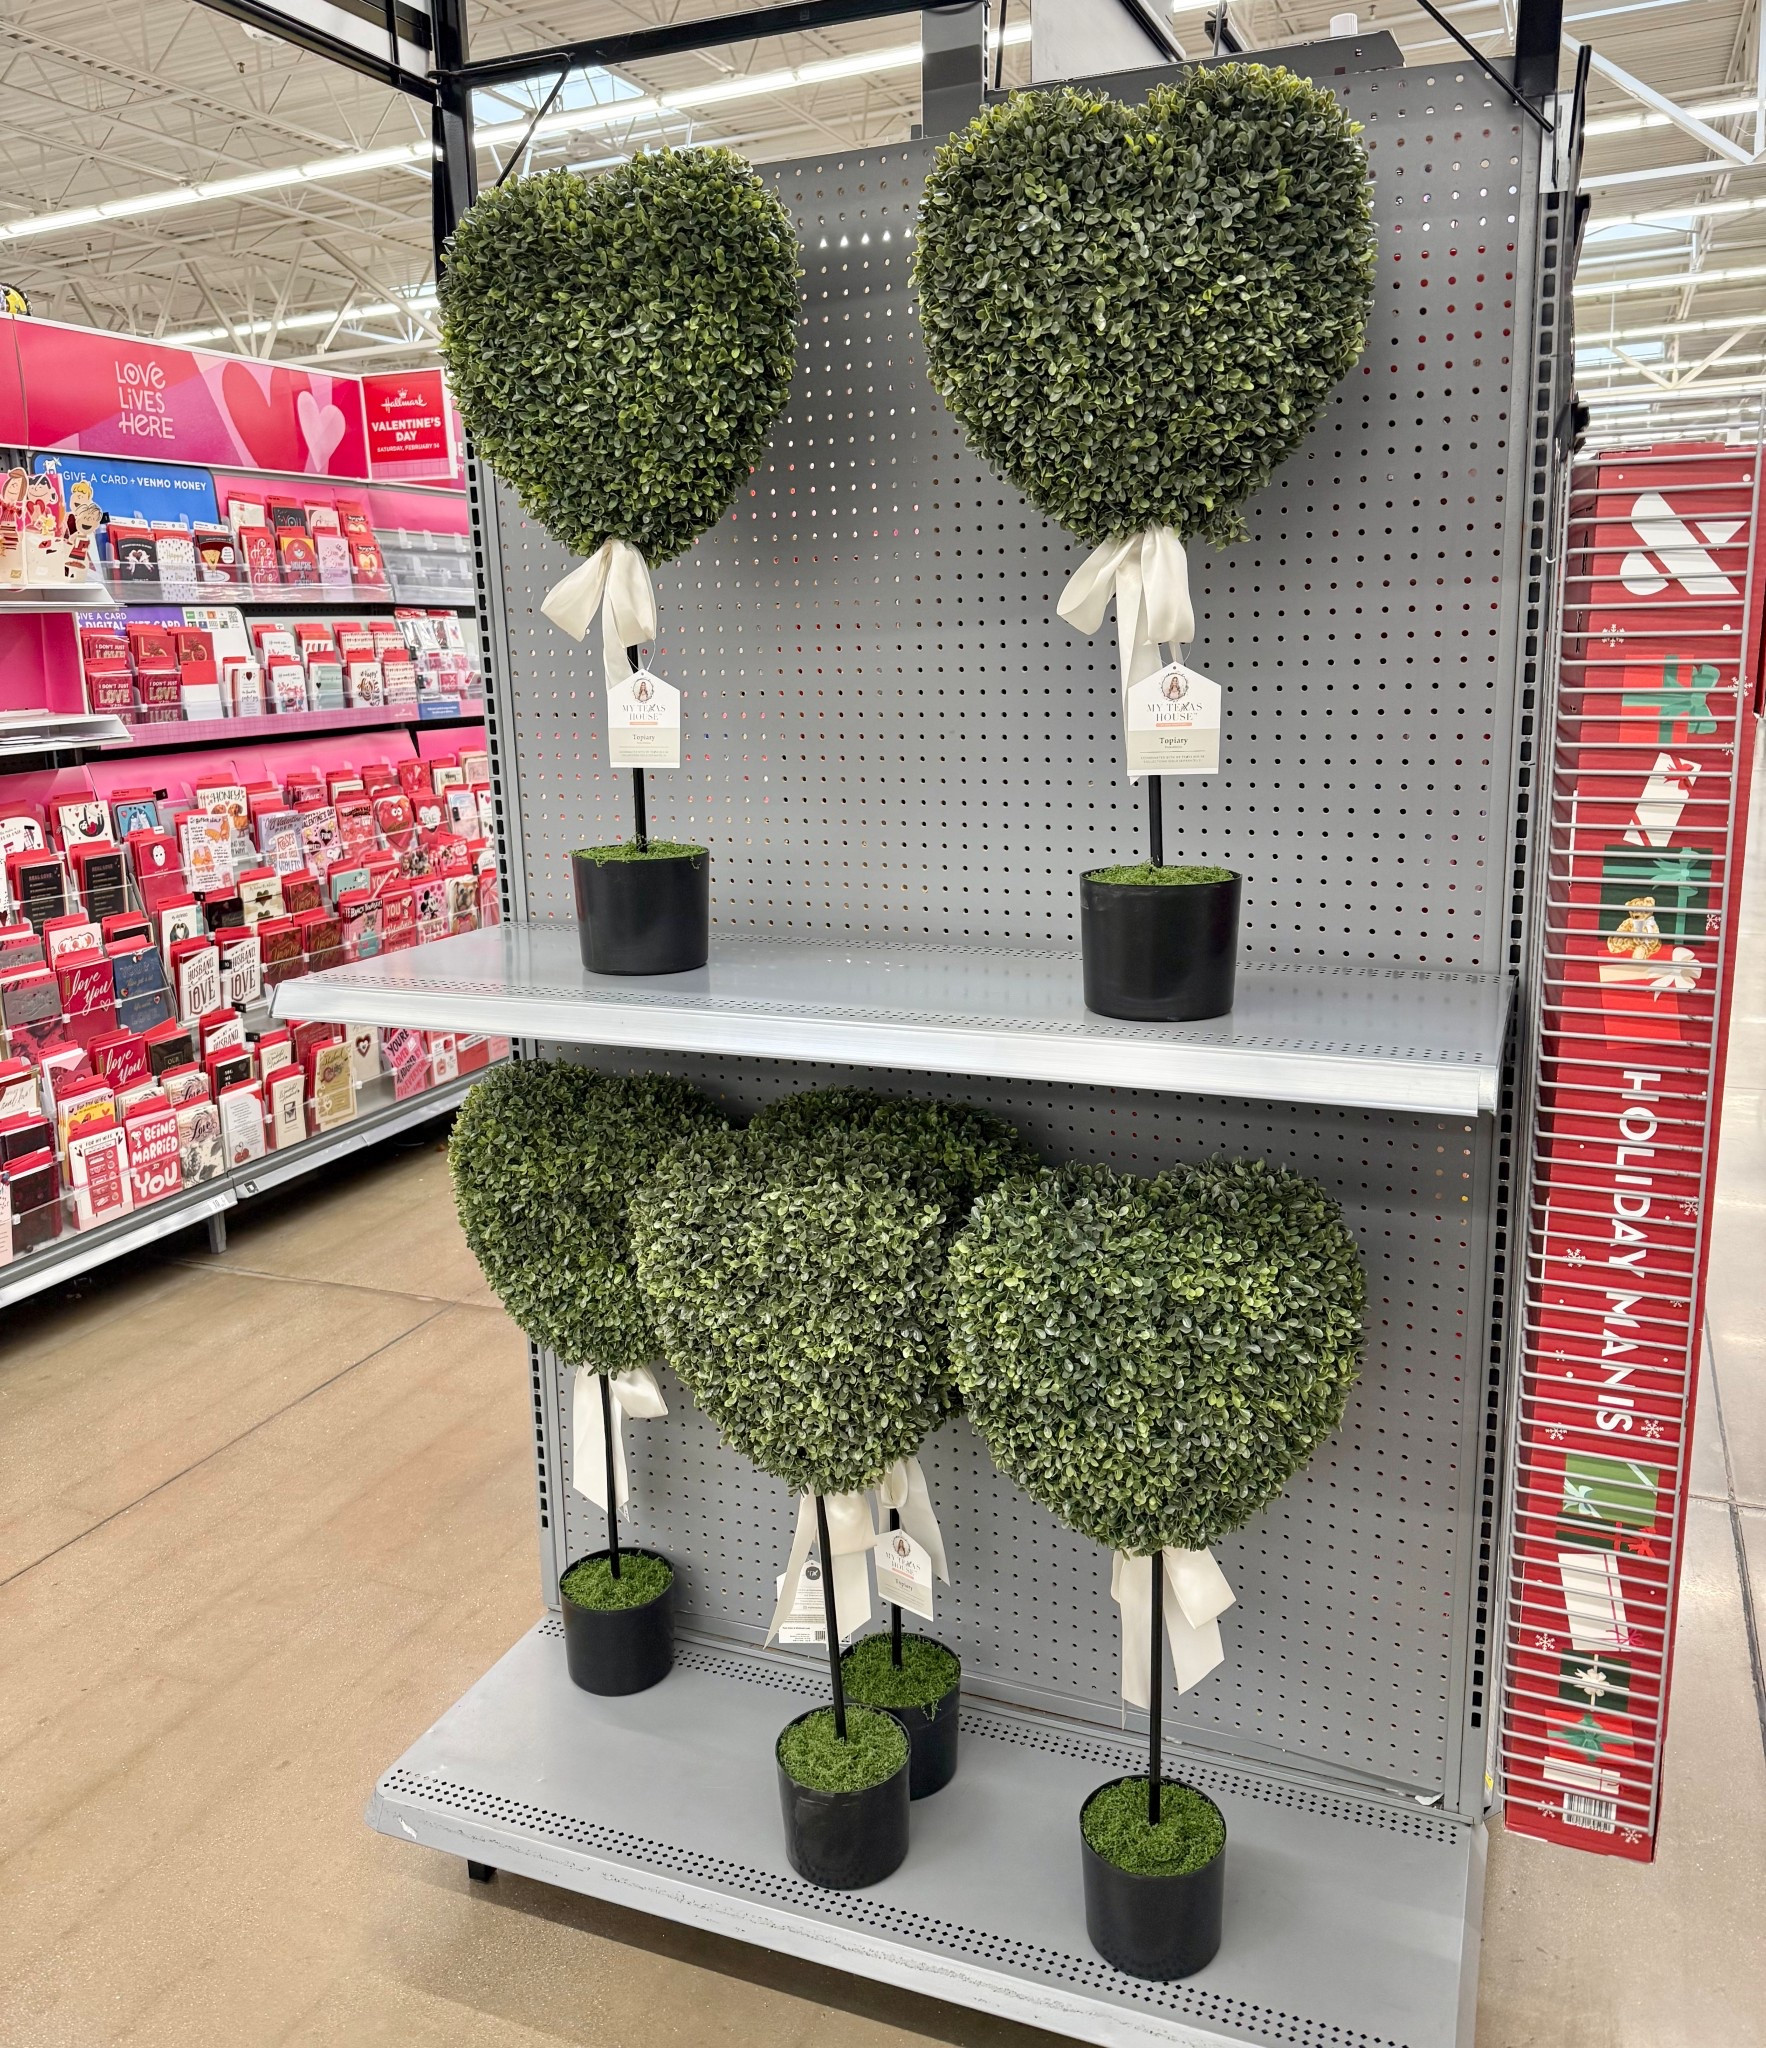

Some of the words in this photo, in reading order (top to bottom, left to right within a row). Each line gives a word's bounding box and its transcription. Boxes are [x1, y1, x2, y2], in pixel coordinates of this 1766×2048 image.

[380, 394, 428, 414] Hallmark
[371, 416, 442, 432] VALENTINE'S
[395, 431, 417, 442] DAY
[405, 443, 433, 452] FEBRUARY
[63, 471, 87, 482] GIVE
[90, 475, 98, 483] A
[101, 474, 128, 485] CARD
[136, 477, 171, 489] VENMO
[174, 481, 207, 491] MONEY
[622, 704, 637, 712] MY
[637, 703, 666, 713] TEXAS
[1147, 703, 1164, 712] MY
[1166, 702, 1203, 712] TEXAS
[633, 734, 655, 742] Topiary
[1159, 737, 1188, 745] Topiary
[386, 903, 400, 917] YOU
[231, 965, 256, 1002] LOVE
[188, 975, 216, 1016] LOVE
[388, 1029, 410, 1057] YOU'RE
[133, 1161, 178, 1198] YOU
[1609, 1070, 1662, 1279] HOLIDAY
[1595, 1290, 1643, 1432] MANIS
